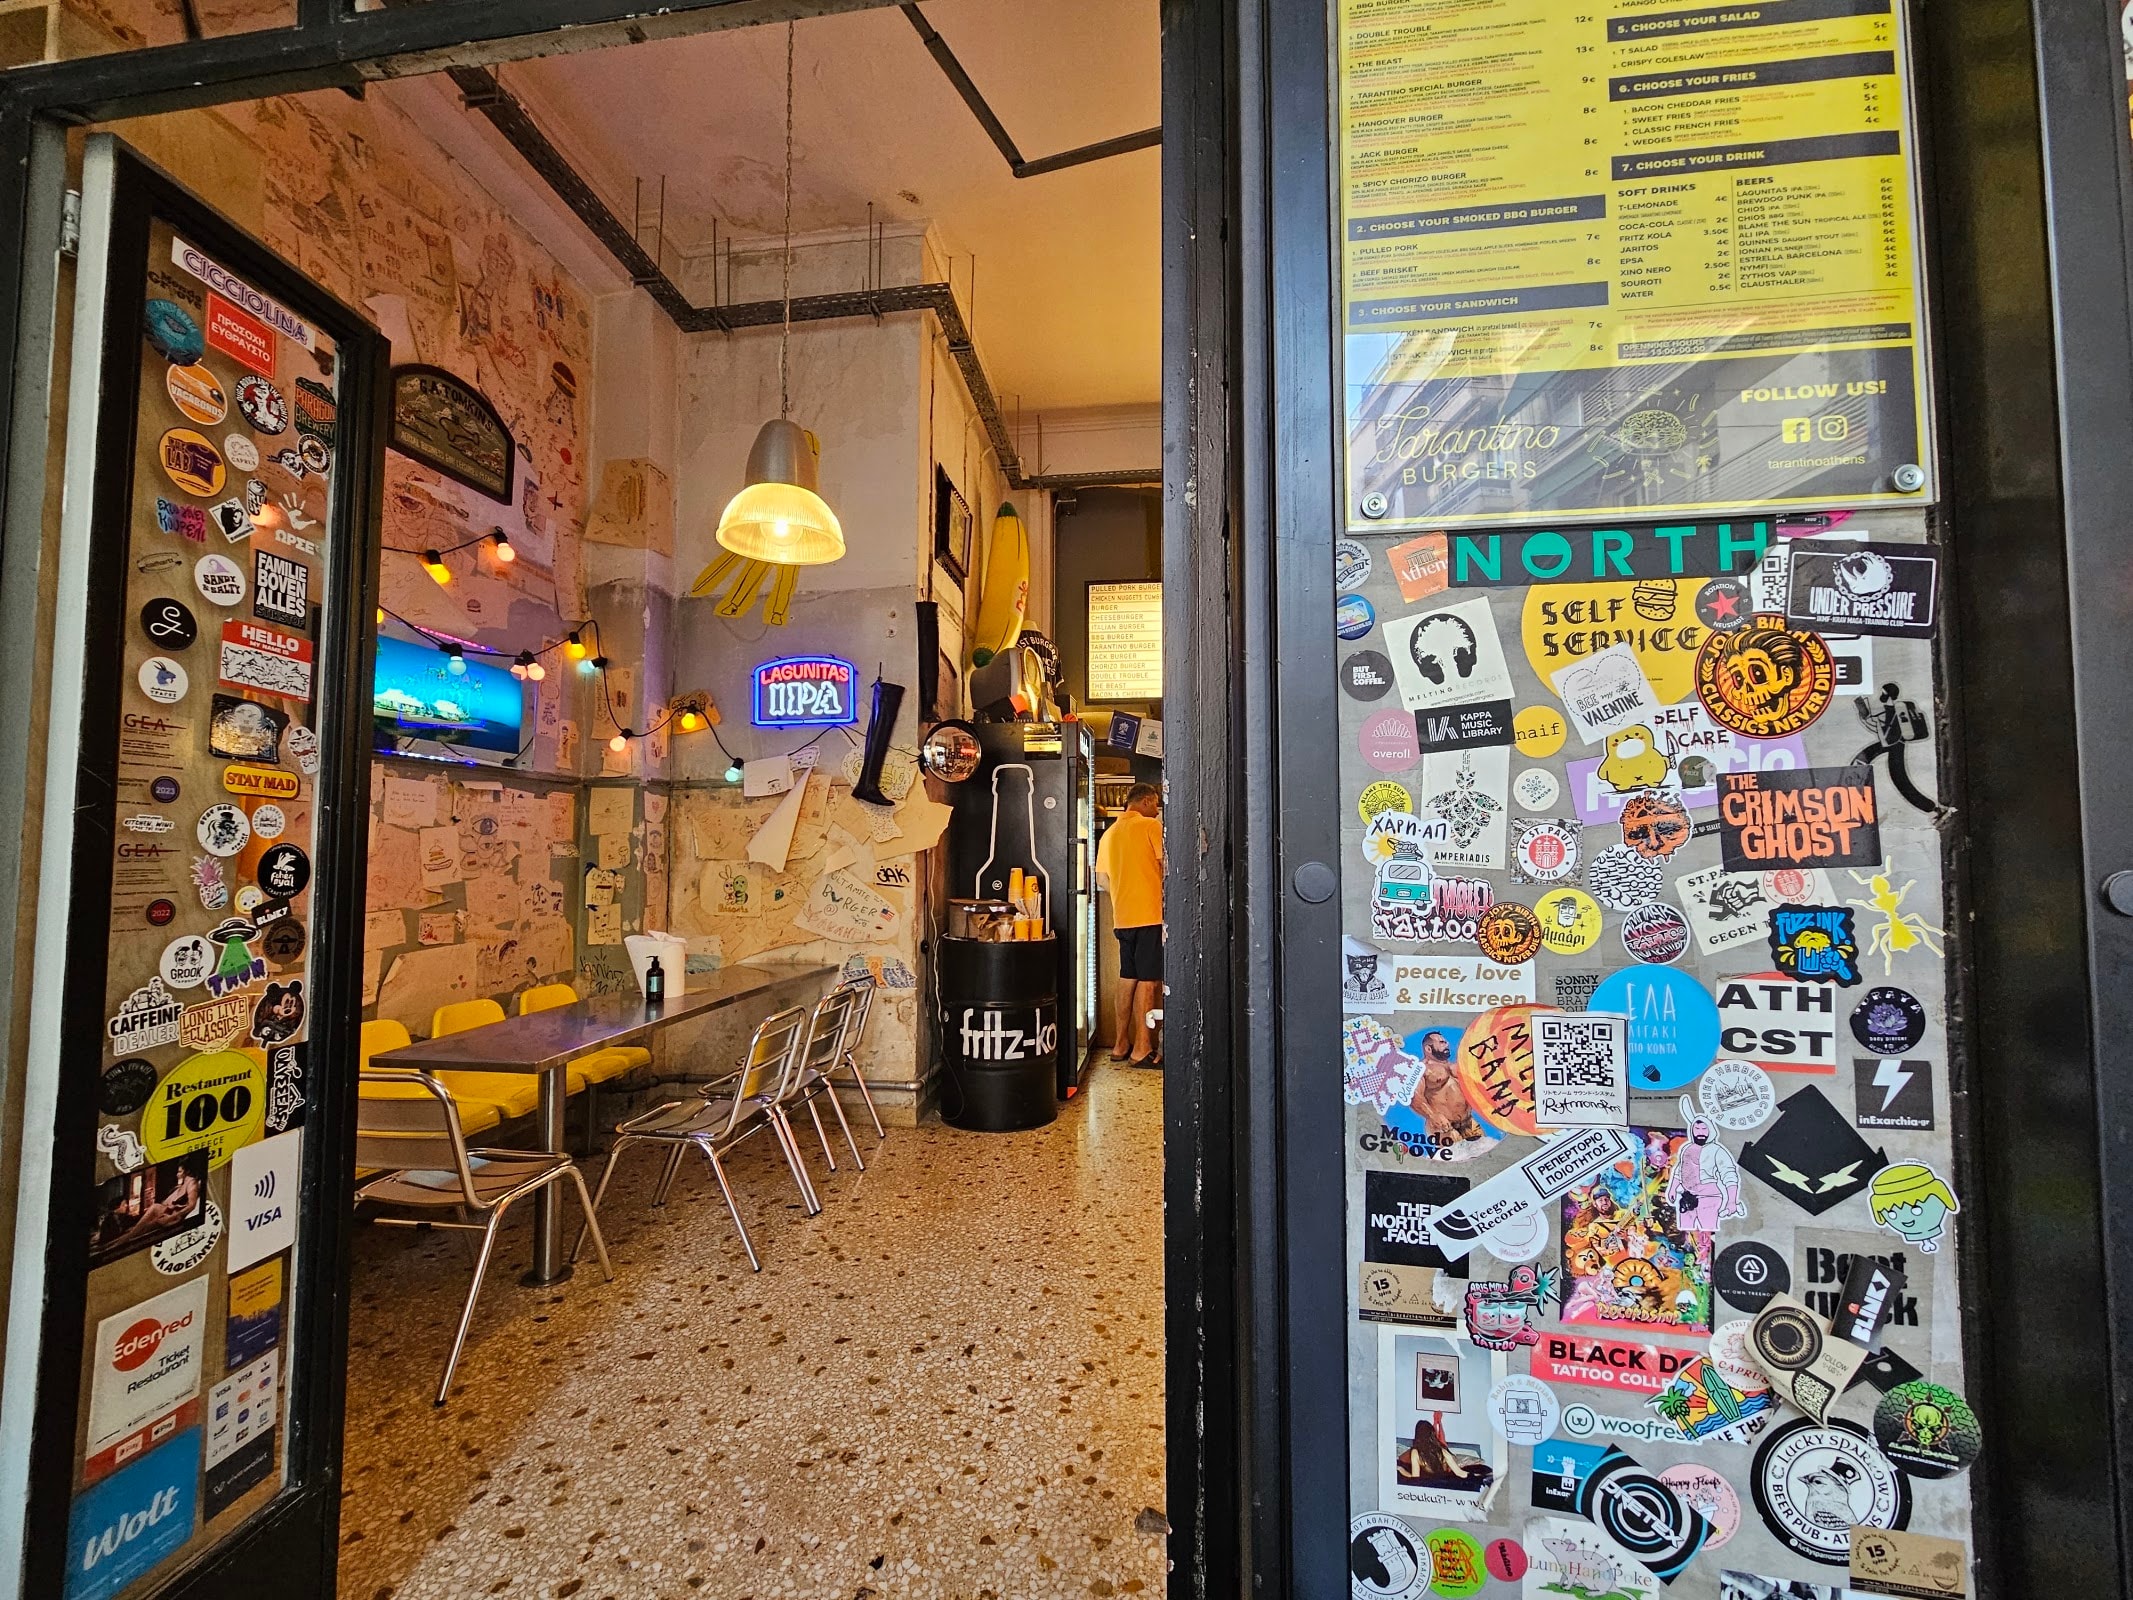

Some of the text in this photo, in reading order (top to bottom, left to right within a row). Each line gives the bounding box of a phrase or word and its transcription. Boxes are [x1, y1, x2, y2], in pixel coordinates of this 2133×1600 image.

[1357, 25, 1432, 39] DOUBLE TROUBLE
[1618, 10, 1760, 34] 5. CHOOSE YOUR SALAD
[1357, 58, 1402, 68] THE BEAST
[1358, 79, 1482, 99] TARANTINO SPECIAL BURGER
[1619, 71, 1756, 93] 6. CHOOSE YOUR FRIES
[1631, 96, 1740, 113] BACON CHEDDAR FRIES
[1622, 150, 1764, 172] 7. CHOOSE YOUR DRINK
[1618, 183, 1696, 197] SOFT DRINKS
[1736, 176, 1773, 186] BEERS
[1357, 205, 1578, 233] 2. CHOOSE YOUR SMOKED BBQ BURGER
[1619, 219, 1674, 231] COCA-COLA
[1704, 261, 1730, 270] 2.50€
[1739, 249, 1842, 263] ESTRELLA BARCELONA
[1740, 277, 1805, 289] CLAUSTHALER
[183, 249, 308, 346] CICCIOLINA
[1621, 290, 1654, 299] WATER
[217, 313, 266, 348] ΠΡΟΣΟΧΗ
[211, 323, 270, 362] ΕΥΘΡΑΥΣΤΟ
[1741, 380, 1887, 403] FOLLOW US!
[296, 387, 336, 420] PARAGON
[296, 408, 336, 436] BREWERY
[1376, 406, 1560, 462] Tarantino
[1403, 461, 1537, 485] BURGERS
[1768, 455, 1866, 469] tarantinoathens
[258, 552, 307, 582] FAMILIE
[204, 575, 236, 585] SANDY
[211, 584, 240, 594] SALTY
[258, 569, 306, 599] BOVEN
[1705, 584, 1735, 596] ROTATION
[256, 587, 305, 617] ALLES
[1542, 598, 1626, 625] SELF
[1809, 587, 1916, 619] UNDER PRESSURE
[1713, 616, 1744, 628] NEUSTADT
[242, 625, 299, 652] HELLO
[760, 664, 849, 685] LAGUNITAS
[1409, 686, 1452, 702] MELTING
[1577, 694, 1599, 711] BEE
[1702, 664, 1831, 734] CLASSICS NEVER DIE
[1460, 711, 1492, 722] KAPPA
[1583, 691, 1644, 727] VALENTINE
[1654, 708, 1698, 725] SELF
[1461, 721, 1493, 730] MUSIC
[1462, 726, 1503, 738] LIBRARY
[1517, 722, 1560, 740] naif
[1678, 730, 1729, 747] CARE
[1372, 749, 1410, 760] overoll
[226, 773, 296, 791] STAY MAD
[1726, 774, 1758, 791] THE
[1722, 786, 1875, 828] CRIMSON
[1548, 826, 1575, 852] PAULI
[1741, 822, 1862, 862] GHOST
[1434, 852, 1490, 863] AMPERIADIS
[1534, 868, 1558, 878] 1910
[256, 907, 288, 926] BLINKY
[1709, 923, 1758, 946] GEGEN
[171, 966, 204, 979] GROOK
[1395, 964, 1521, 982] peace, love
[1555, 975, 1599, 985] SONNY
[1396, 988, 1526, 1006] & silkscreen
[1717, 983, 1832, 1013] ATH
[182, 999, 245, 1029] LONG LIVE
[117, 1023, 177, 1054] DEALER
[190, 1016, 239, 1041] CLASSICS
[1720, 1027, 1832, 1056] CST
[1715, 1064, 1762, 1081] HERBIE
[165, 1069, 252, 1101] Restaurant
[160, 1085, 252, 1142] 100
[1730, 1085, 1769, 1126] RECORDS
[1381, 1124, 1454, 1146] Mondo
[1538, 1131, 1603, 1175] ΡΕΠΕΡΤΟΡΙΟ
[1546, 1142, 1610, 1184] ΠΟΙΟΤΗΤΟΣ
[244, 1207, 282, 1232] VISA
[1469, 1200, 1507, 1223] Veego
[1476, 1200, 1528, 1234] Records
[1373, 1278, 1390, 1291] 15
[1470, 1282, 1488, 1293] ARIS
[1851, 1269, 1891, 1343] BLINKY
[114, 1311, 193, 1361] Edenred
[159, 1345, 190, 1367] Ticket
[1550, 1340, 1647, 1371] BLACK
[1822, 1352, 1850, 1372] FOLLOW
[126, 1356, 190, 1394] Restaurant
[1551, 1363, 1614, 1381] TATTOO
[1718, 1360, 1769, 1384] CAPRUS
[1661, 1477, 1690, 1489] Happy
[1772, 1483, 1821, 1540] BEER PUB
[83, 1485, 181, 1571] Wolt
